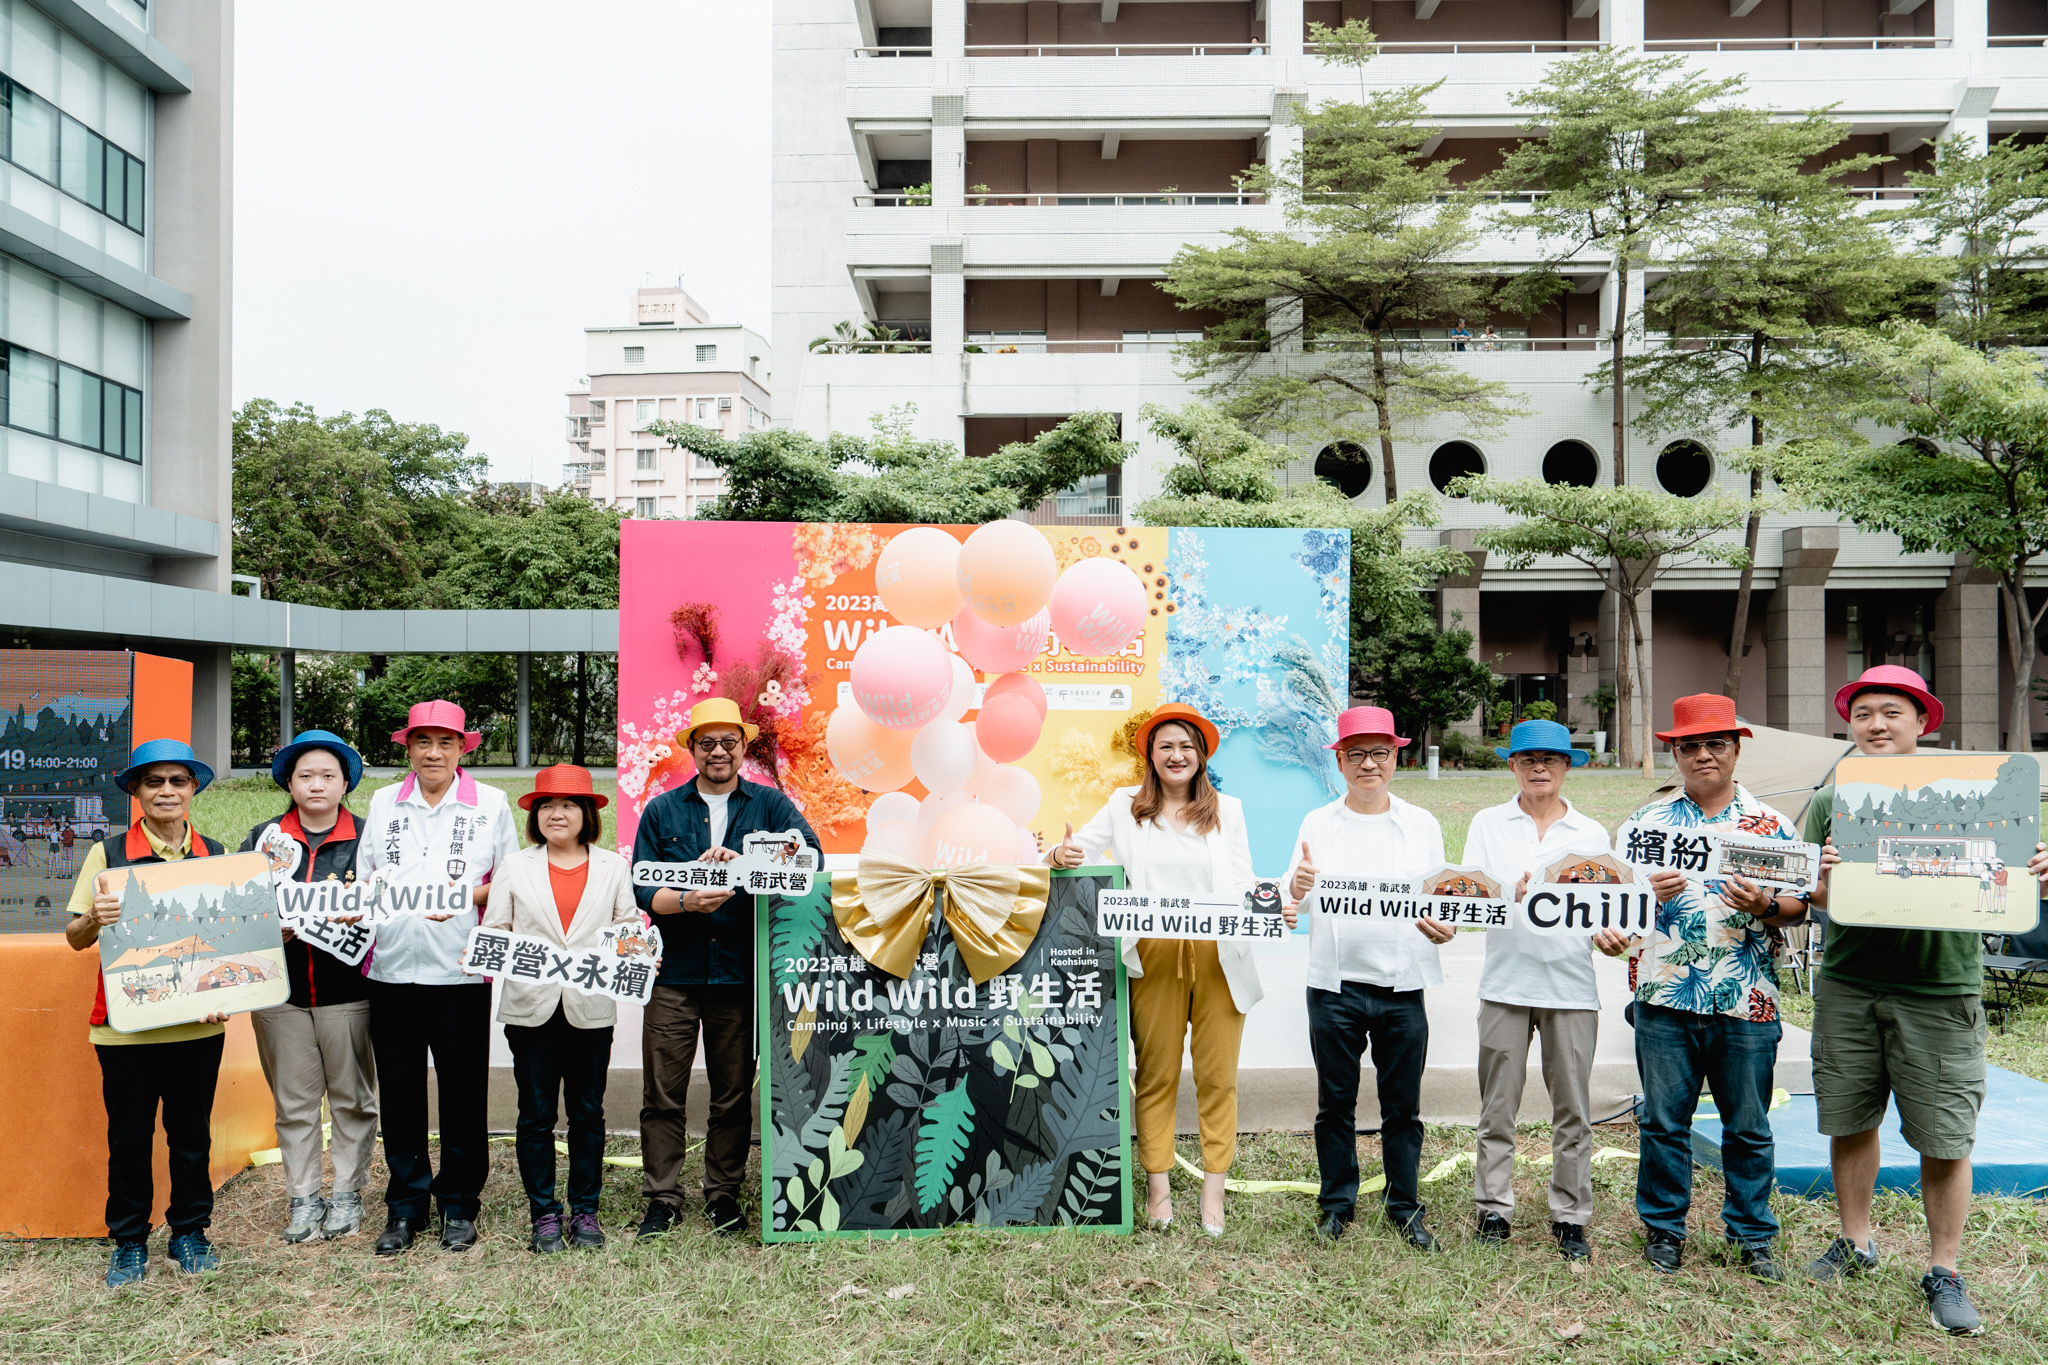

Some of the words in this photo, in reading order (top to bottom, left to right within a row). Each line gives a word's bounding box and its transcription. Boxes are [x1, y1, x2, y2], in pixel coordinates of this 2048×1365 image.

[1091, 601, 1134, 644] Wild
[1046, 660, 1144, 675] Sustainability
[860, 691, 913, 712] Wild
[28, 757, 98, 769] 14:00-21:00
[449, 815, 467, 856] 許智傑
[936, 840, 988, 865] Wild
[1625, 827, 1713, 872] 繽紛
[282, 885, 362, 913] Wild
[389, 884, 467, 911] Wild
[1320, 896, 1372, 916] Wild
[1380, 899, 1432, 919] Wild
[1439, 902, 1507, 926] 野生活
[1527, 891, 1649, 929] Chill
[1103, 913, 1154, 932] Wild
[1161, 915, 1212, 934] Wild
[1218, 915, 1284, 938] 野生活
[1050, 947, 1083, 956] Hosted
[1086, 946, 1095, 955] in
[1050, 957, 1099, 967] Kaohsiung
[783, 979, 873, 1012] Wild
[886, 977, 977, 1010] Wild
[988, 971, 1102, 1010] 野生活
[787, 1020, 848, 1034] Camping
[867, 1017, 928, 1031] Lifestyle
[946, 1016, 987, 1028] Music
[1006, 1013, 1103, 1026] Sustainability
